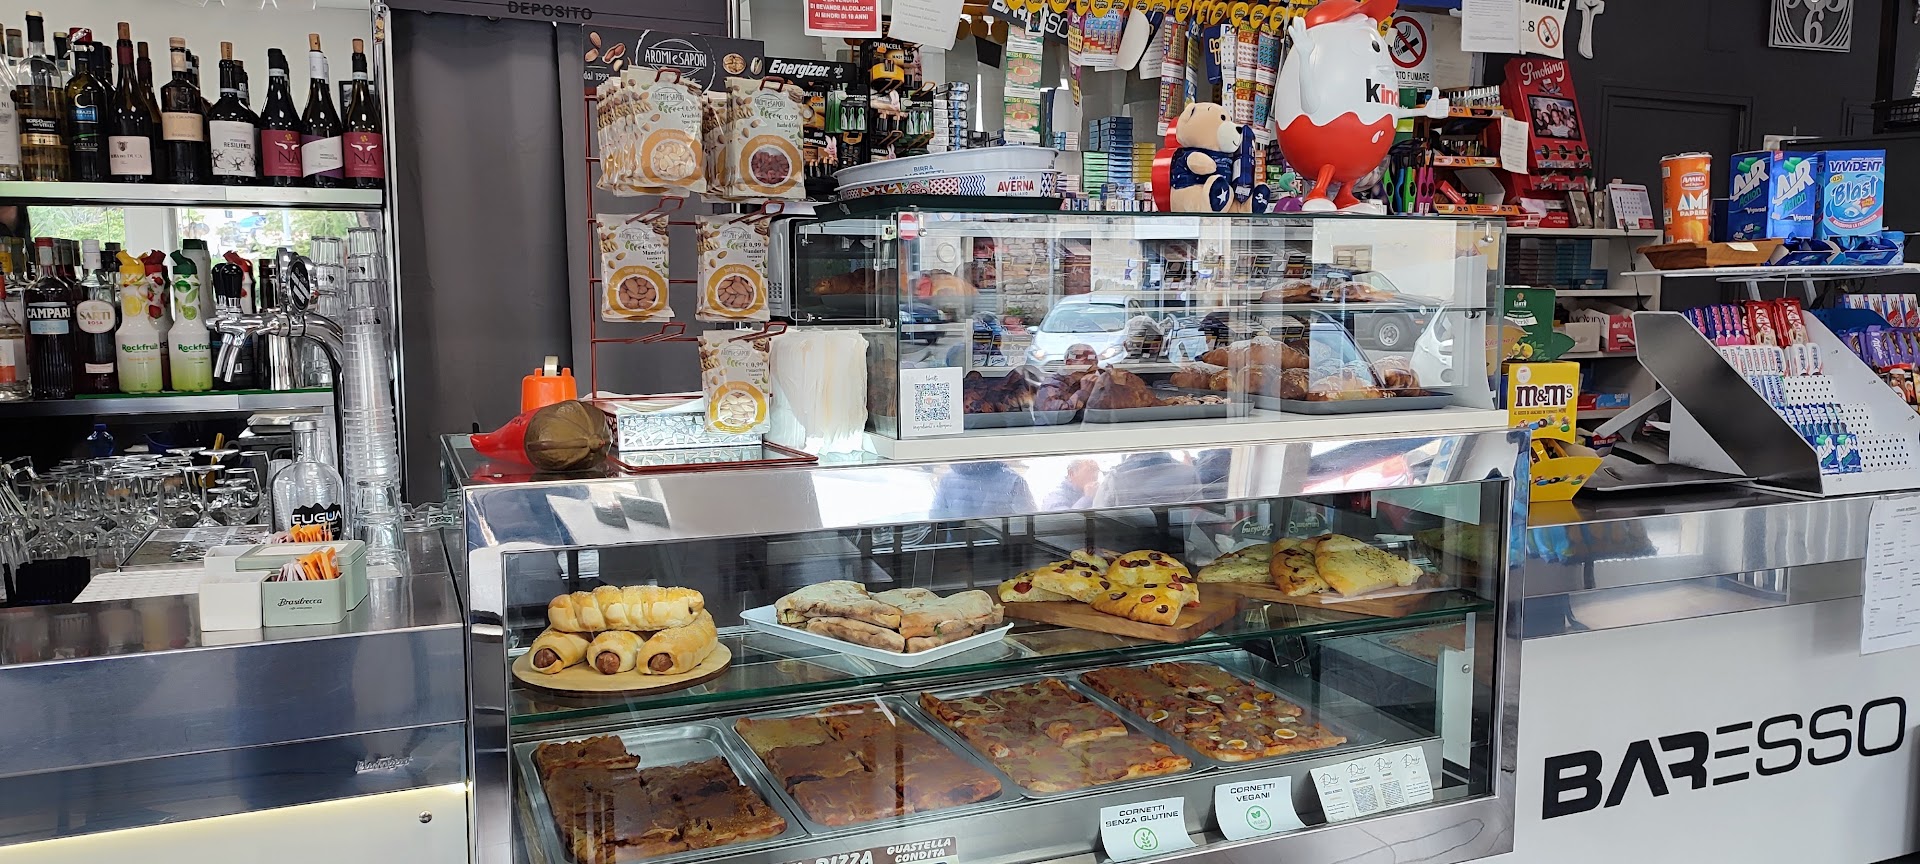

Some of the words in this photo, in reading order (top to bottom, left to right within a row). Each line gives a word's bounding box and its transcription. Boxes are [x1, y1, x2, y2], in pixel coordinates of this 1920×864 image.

[508, 1, 592, 20] DEPOSITO
[873, 42, 902, 50] DURACELL
[644, 49, 672, 63] AROMI
[678, 52, 707, 67] SAPORI
[583, 71, 594, 80] dal
[768, 60, 830, 78] Energizer
[1520, 61, 1565, 86] Smoking
[1407, 71, 1430, 81] FUMARE
[913, 165, 934, 173] BIRRA
[1829, 161, 1883, 173] VIVIDENT
[997, 180, 1035, 193] AVERNA
[1729, 160, 1769, 201] AIR
[1772, 159, 1815, 206] AIR
[1831, 175, 1878, 206] Blast
[26, 307, 71, 319] CAMPARI
[79, 309, 112, 321] SARTI
[121, 343, 159, 353] Rockfruit
[1541, 696, 1907, 820] BARESSO
[1230, 782, 1276, 795] CORNETTI
[1235, 792, 1271, 803] VEGANI
[1119, 804, 1165, 817] CORNETTI
[1105, 817, 1138, 828] SENZA
[1140, 810, 1179, 822] GLUTINE
[886, 837, 951, 856] GUASTELLA
[895, 849, 946, 863] CONDITA
